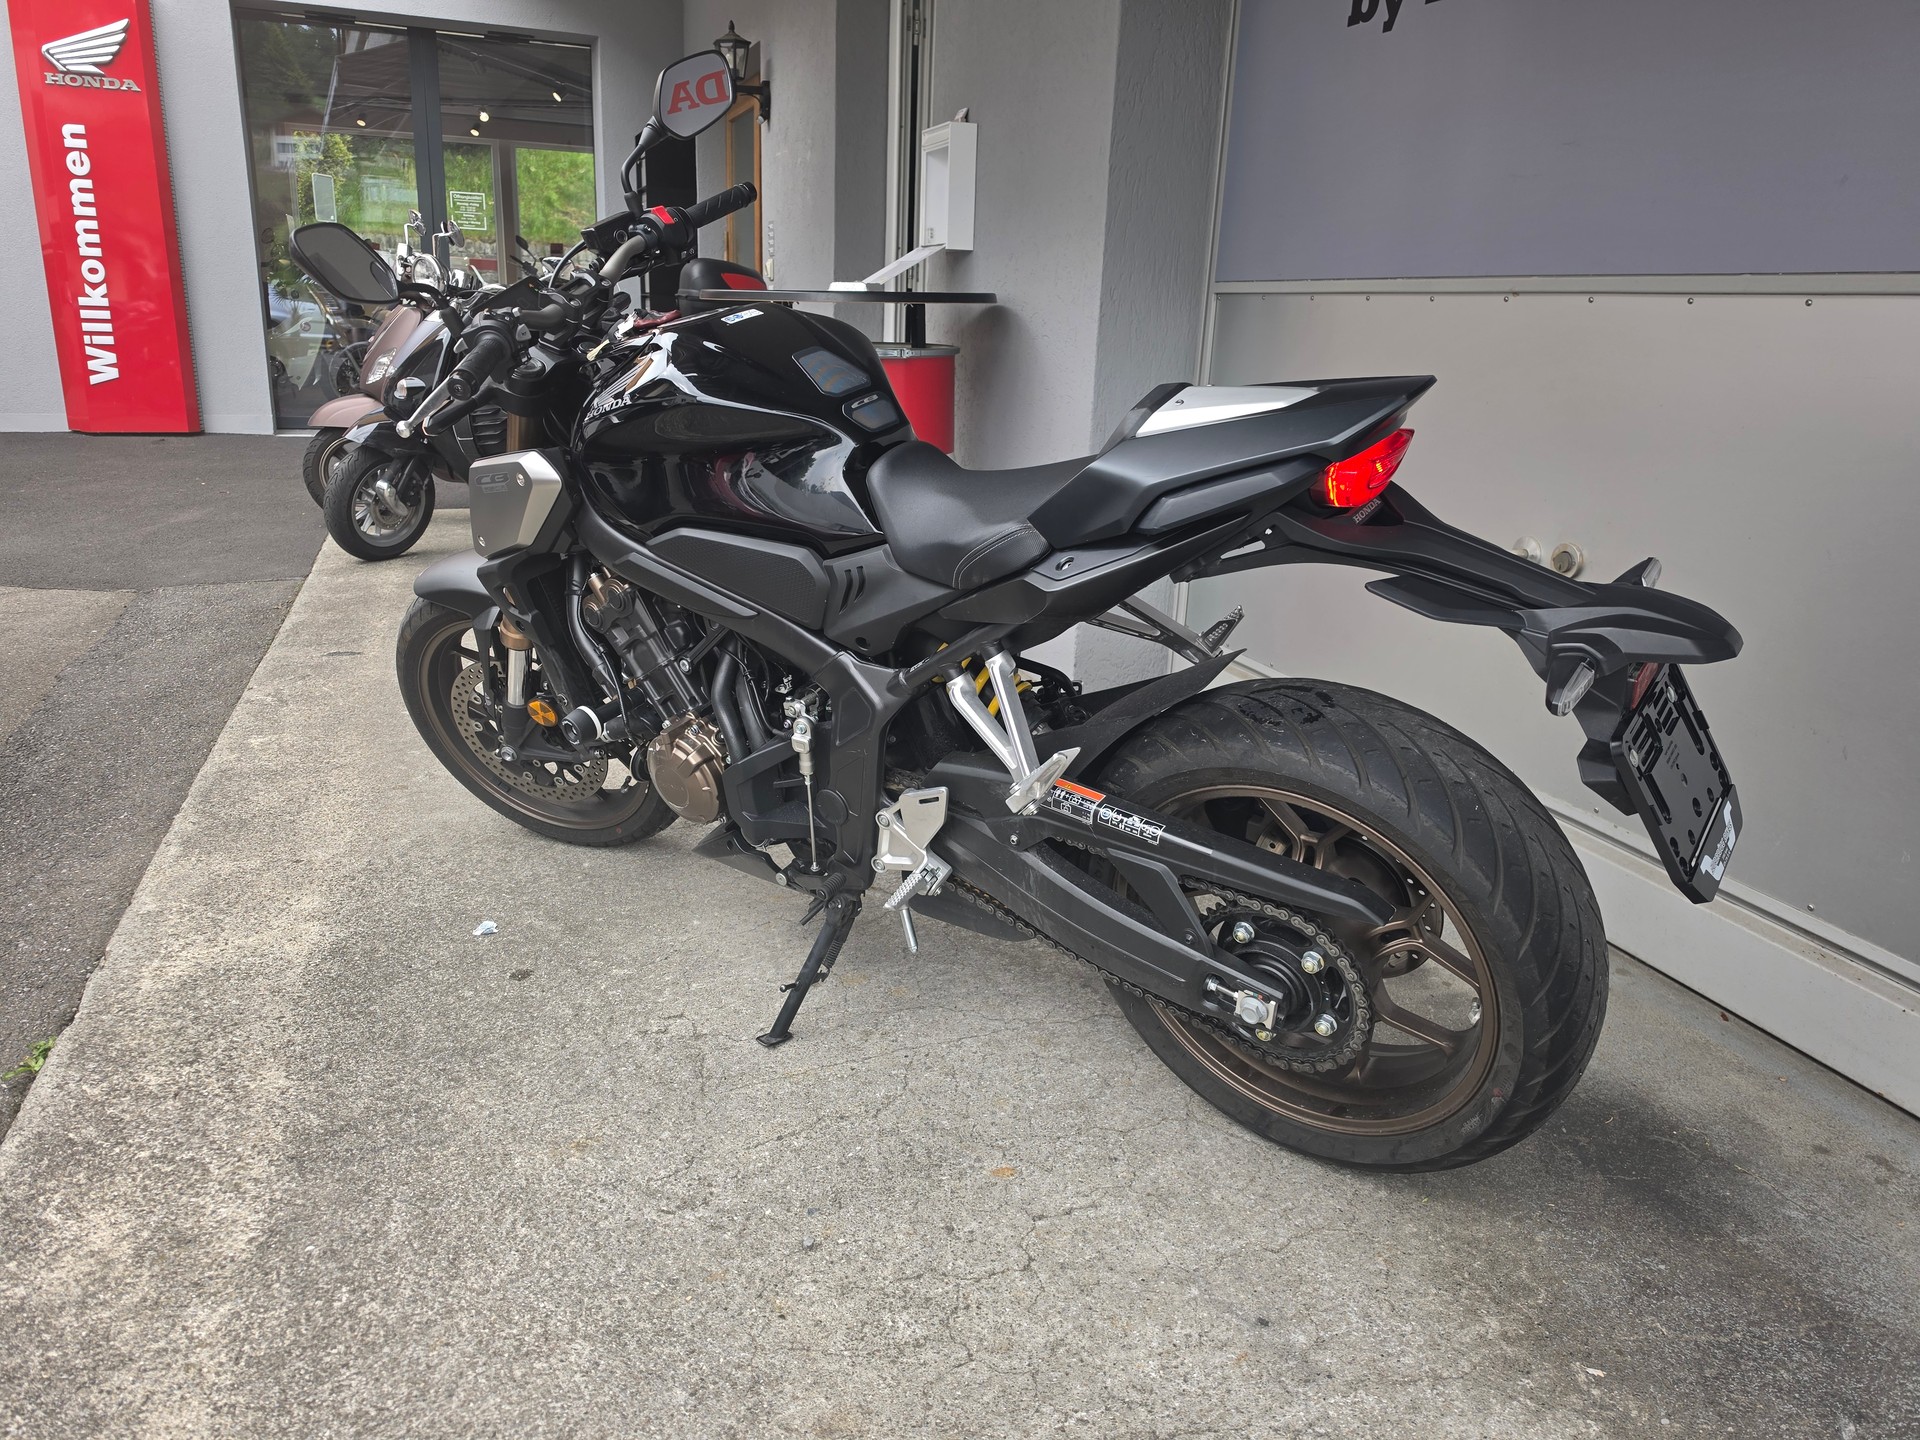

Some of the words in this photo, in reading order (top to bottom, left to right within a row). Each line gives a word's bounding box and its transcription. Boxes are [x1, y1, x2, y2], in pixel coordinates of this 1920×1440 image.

[44, 72, 141, 91] HONDA
[62, 123, 119, 385] Willkommen
[584, 396, 632, 421] HONDA
[1353, 498, 1381, 523] HONDA
